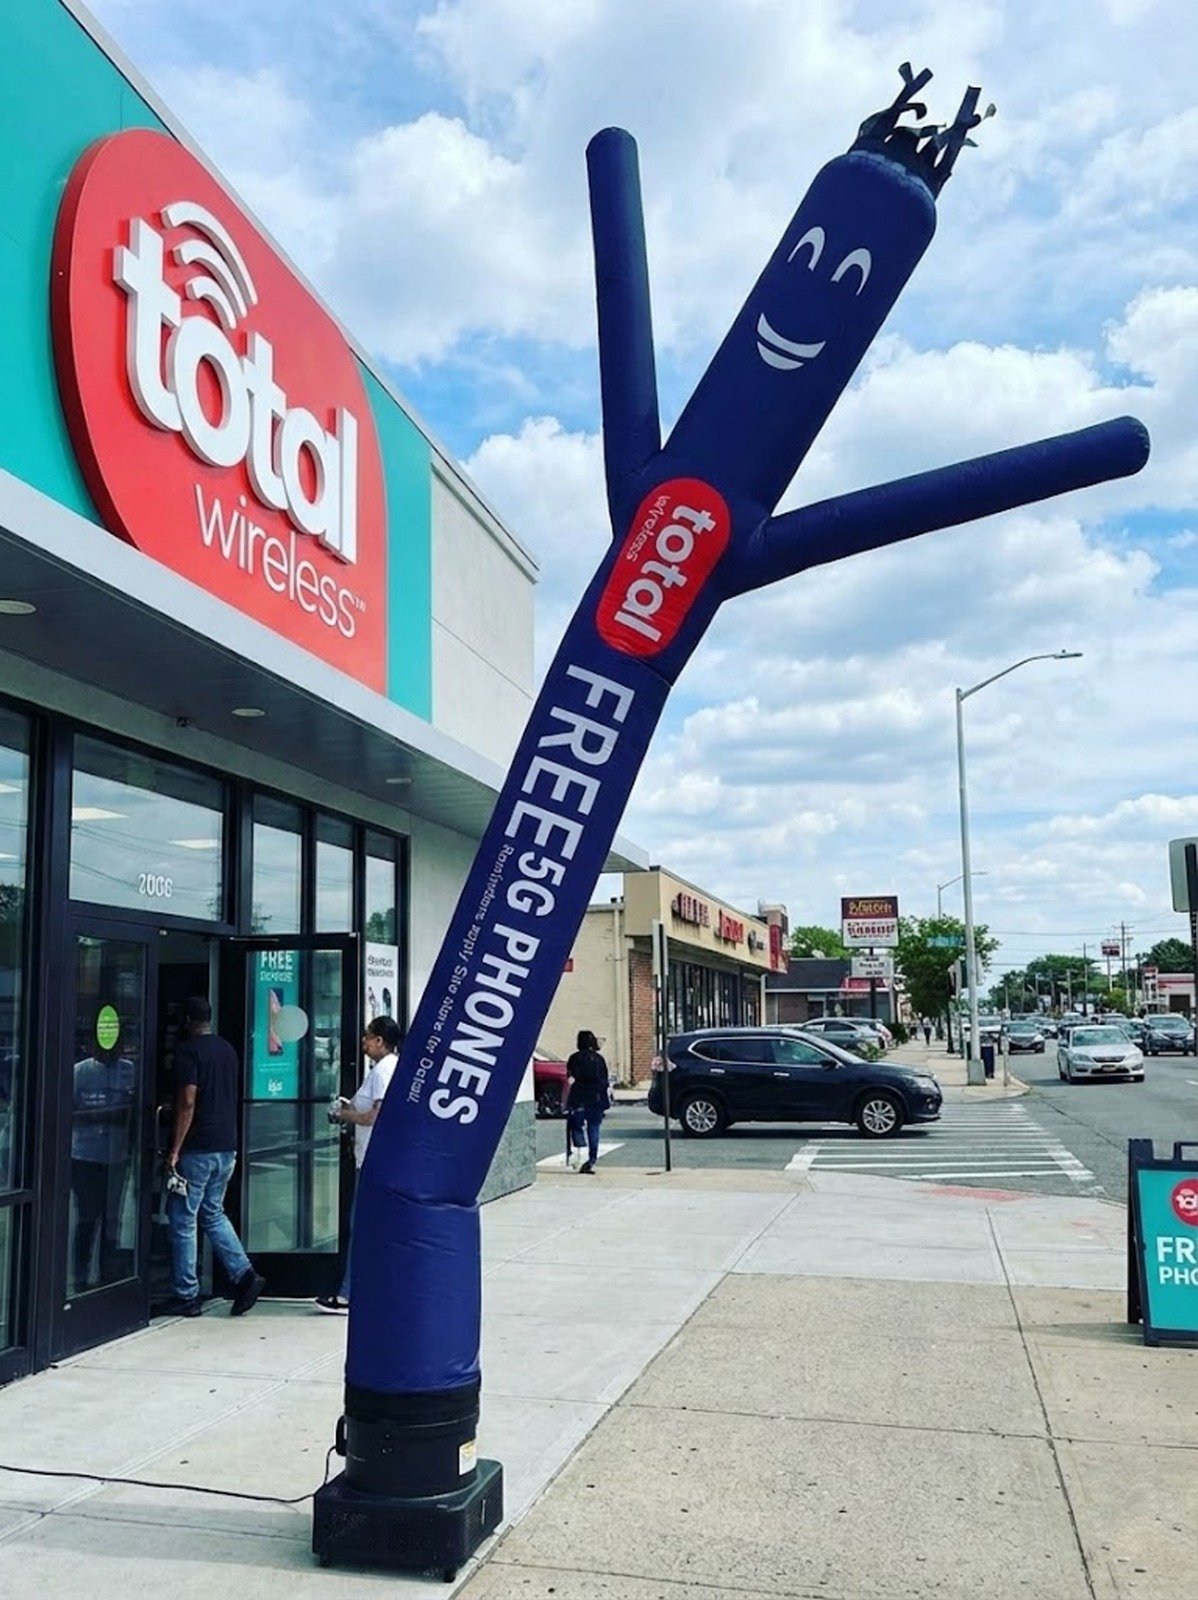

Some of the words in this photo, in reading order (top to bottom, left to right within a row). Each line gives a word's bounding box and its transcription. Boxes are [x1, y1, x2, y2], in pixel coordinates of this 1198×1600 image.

[113, 216, 358, 564] total
[613, 504, 717, 642] total
[504, 664, 635, 861] FREE
[506, 850, 567, 917] 5G
[428, 922, 541, 1125] PHONES
